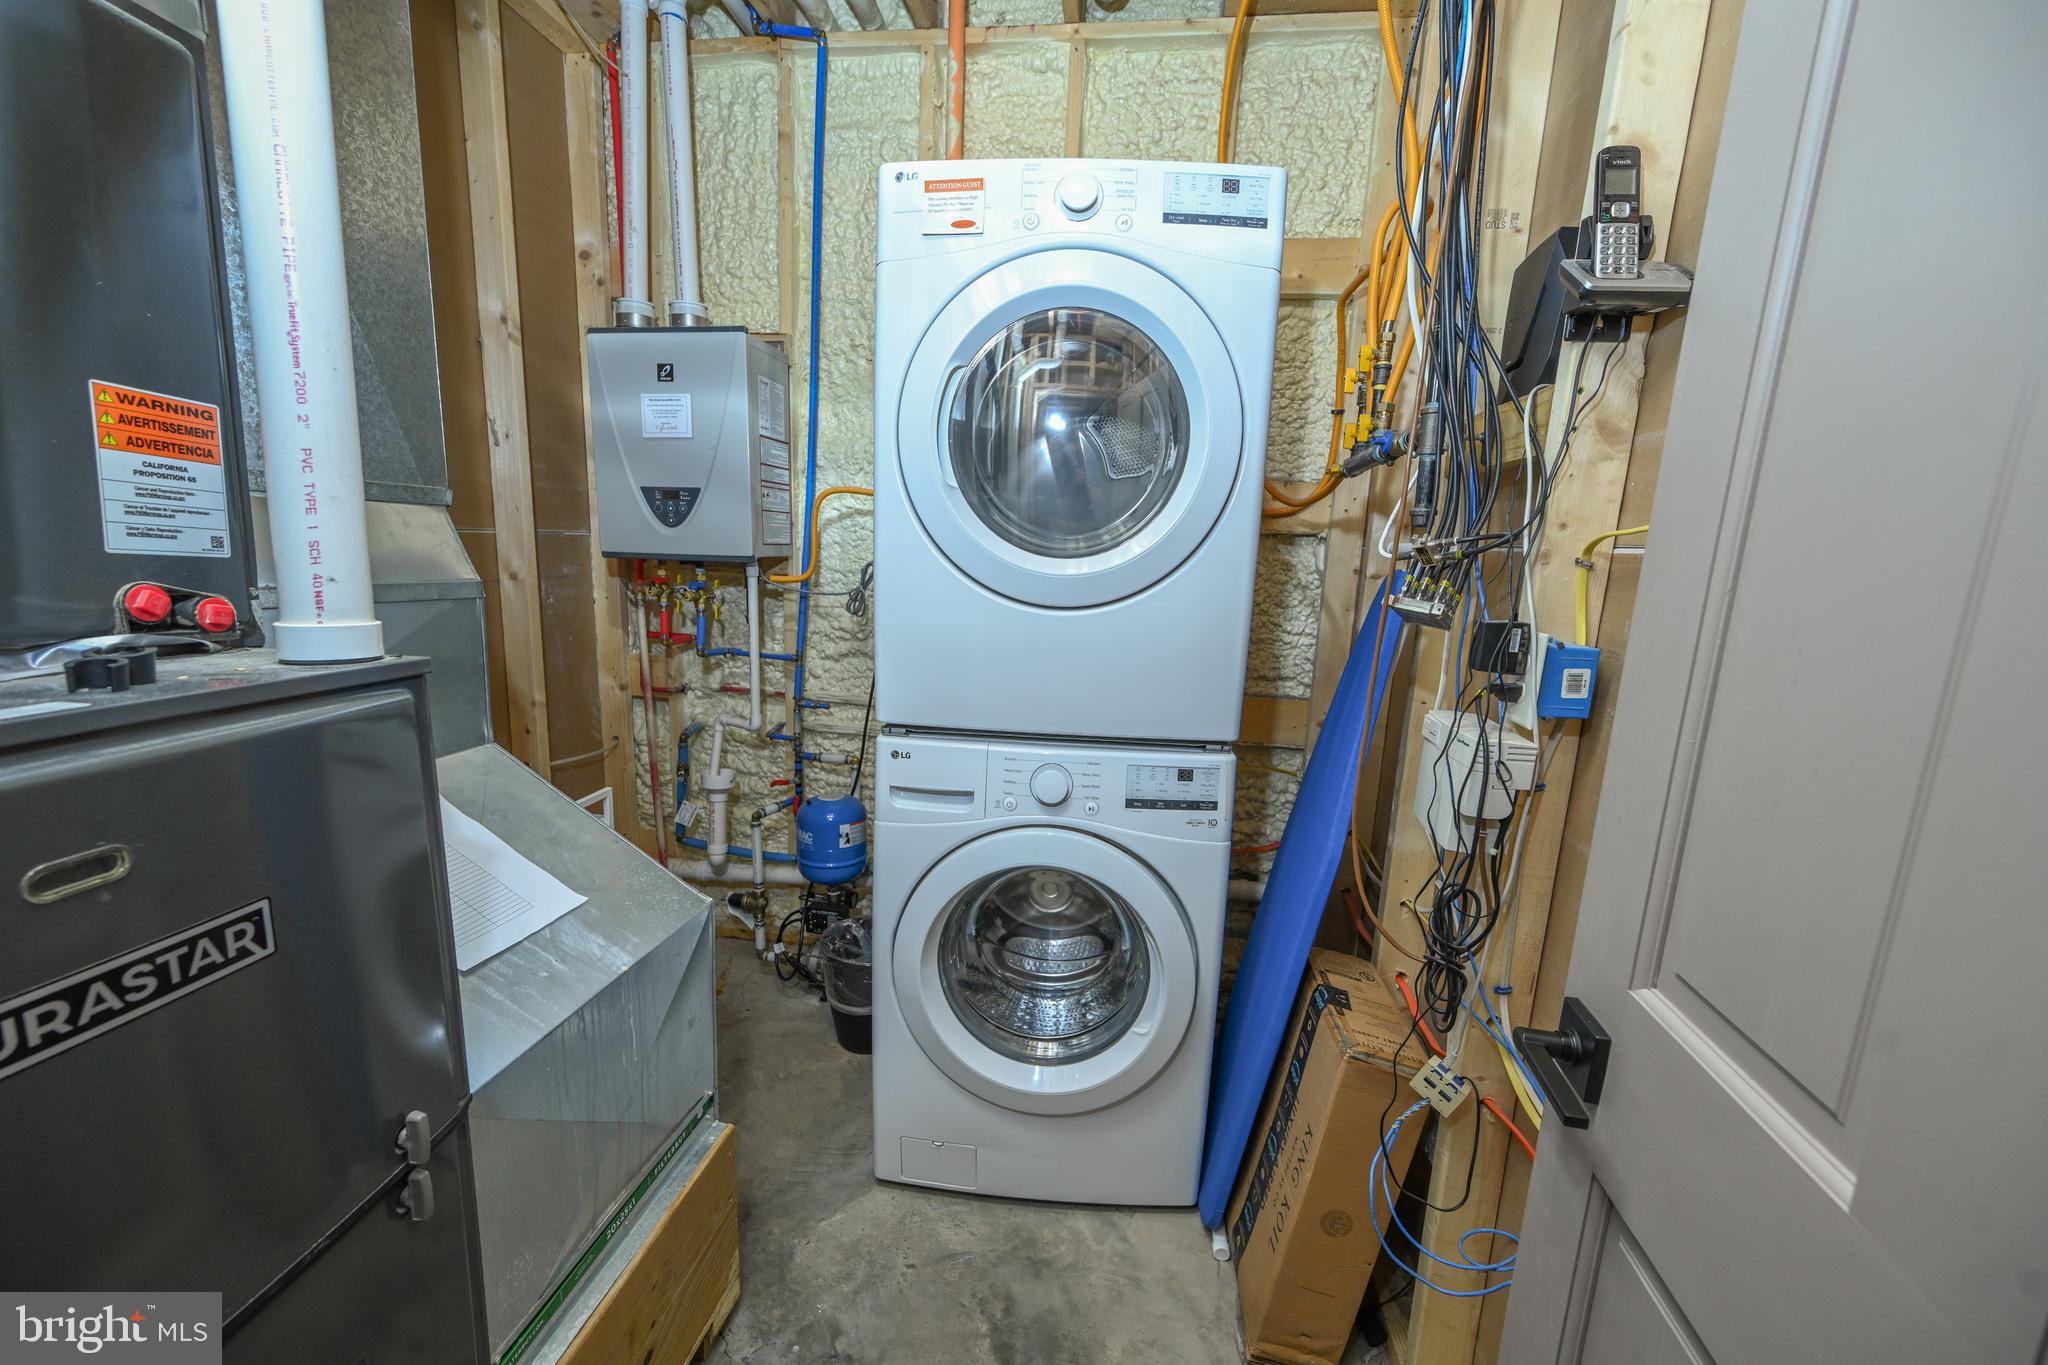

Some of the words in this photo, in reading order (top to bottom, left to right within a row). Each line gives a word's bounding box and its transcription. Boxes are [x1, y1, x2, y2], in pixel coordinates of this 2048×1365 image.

[906, 172, 919, 181] LG
[293, 371, 308, 405] 7200
[115, 392, 214, 421] WARNING
[118, 413, 215, 441] AVERTISSEMENT
[126, 436, 215, 459] ADVERTENCIA
[300, 448, 314, 474] PVC
[133, 469, 186, 482] PROPOSITION
[142, 461, 188, 473] CALIFORNIA
[303, 482, 318, 515] TYPE
[308, 540, 322, 565] SCH
[312, 573, 324, 589] 40
[900, 752, 911, 760] LG
[0, 920, 269, 1062] URASTAR
[1292, 1122, 1314, 1187] KING
[606, 1197, 636, 1240] 20x25x1
[1268, 1194, 1290, 1253] KOIL
